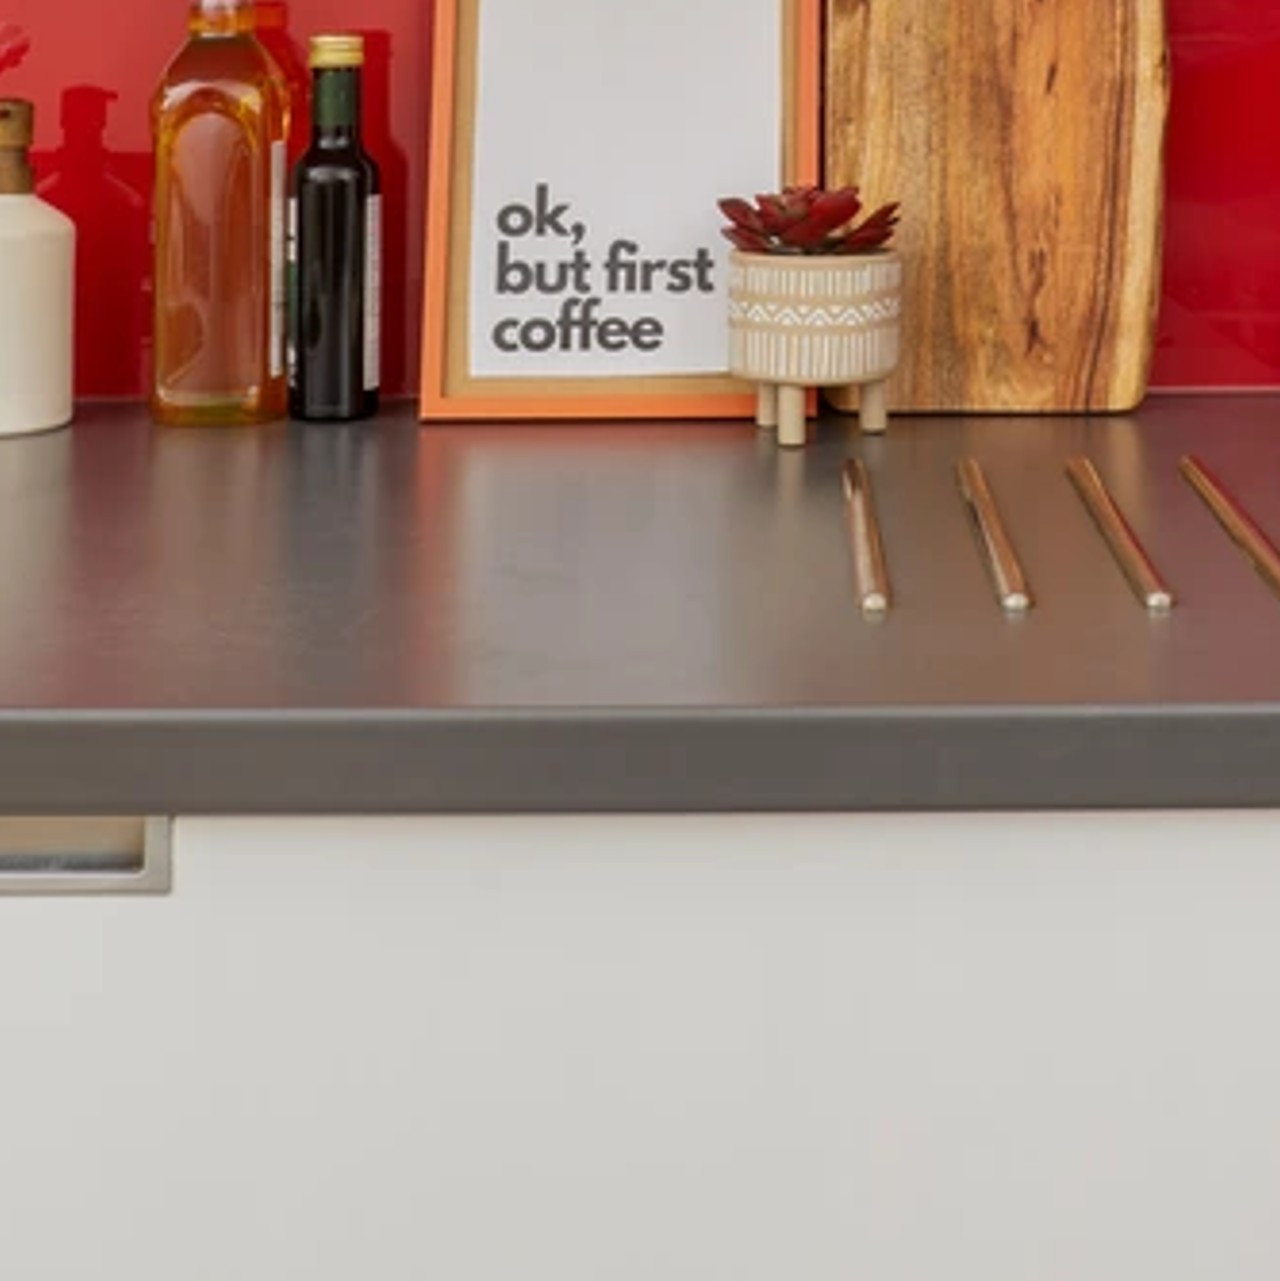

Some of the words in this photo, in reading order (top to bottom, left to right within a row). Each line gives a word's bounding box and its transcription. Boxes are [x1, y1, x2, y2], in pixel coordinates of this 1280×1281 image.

[495, 183, 586, 245] ok,
[495, 241, 592, 294] but
[604, 240, 715, 293] first
[492, 297, 664, 352] coffee
